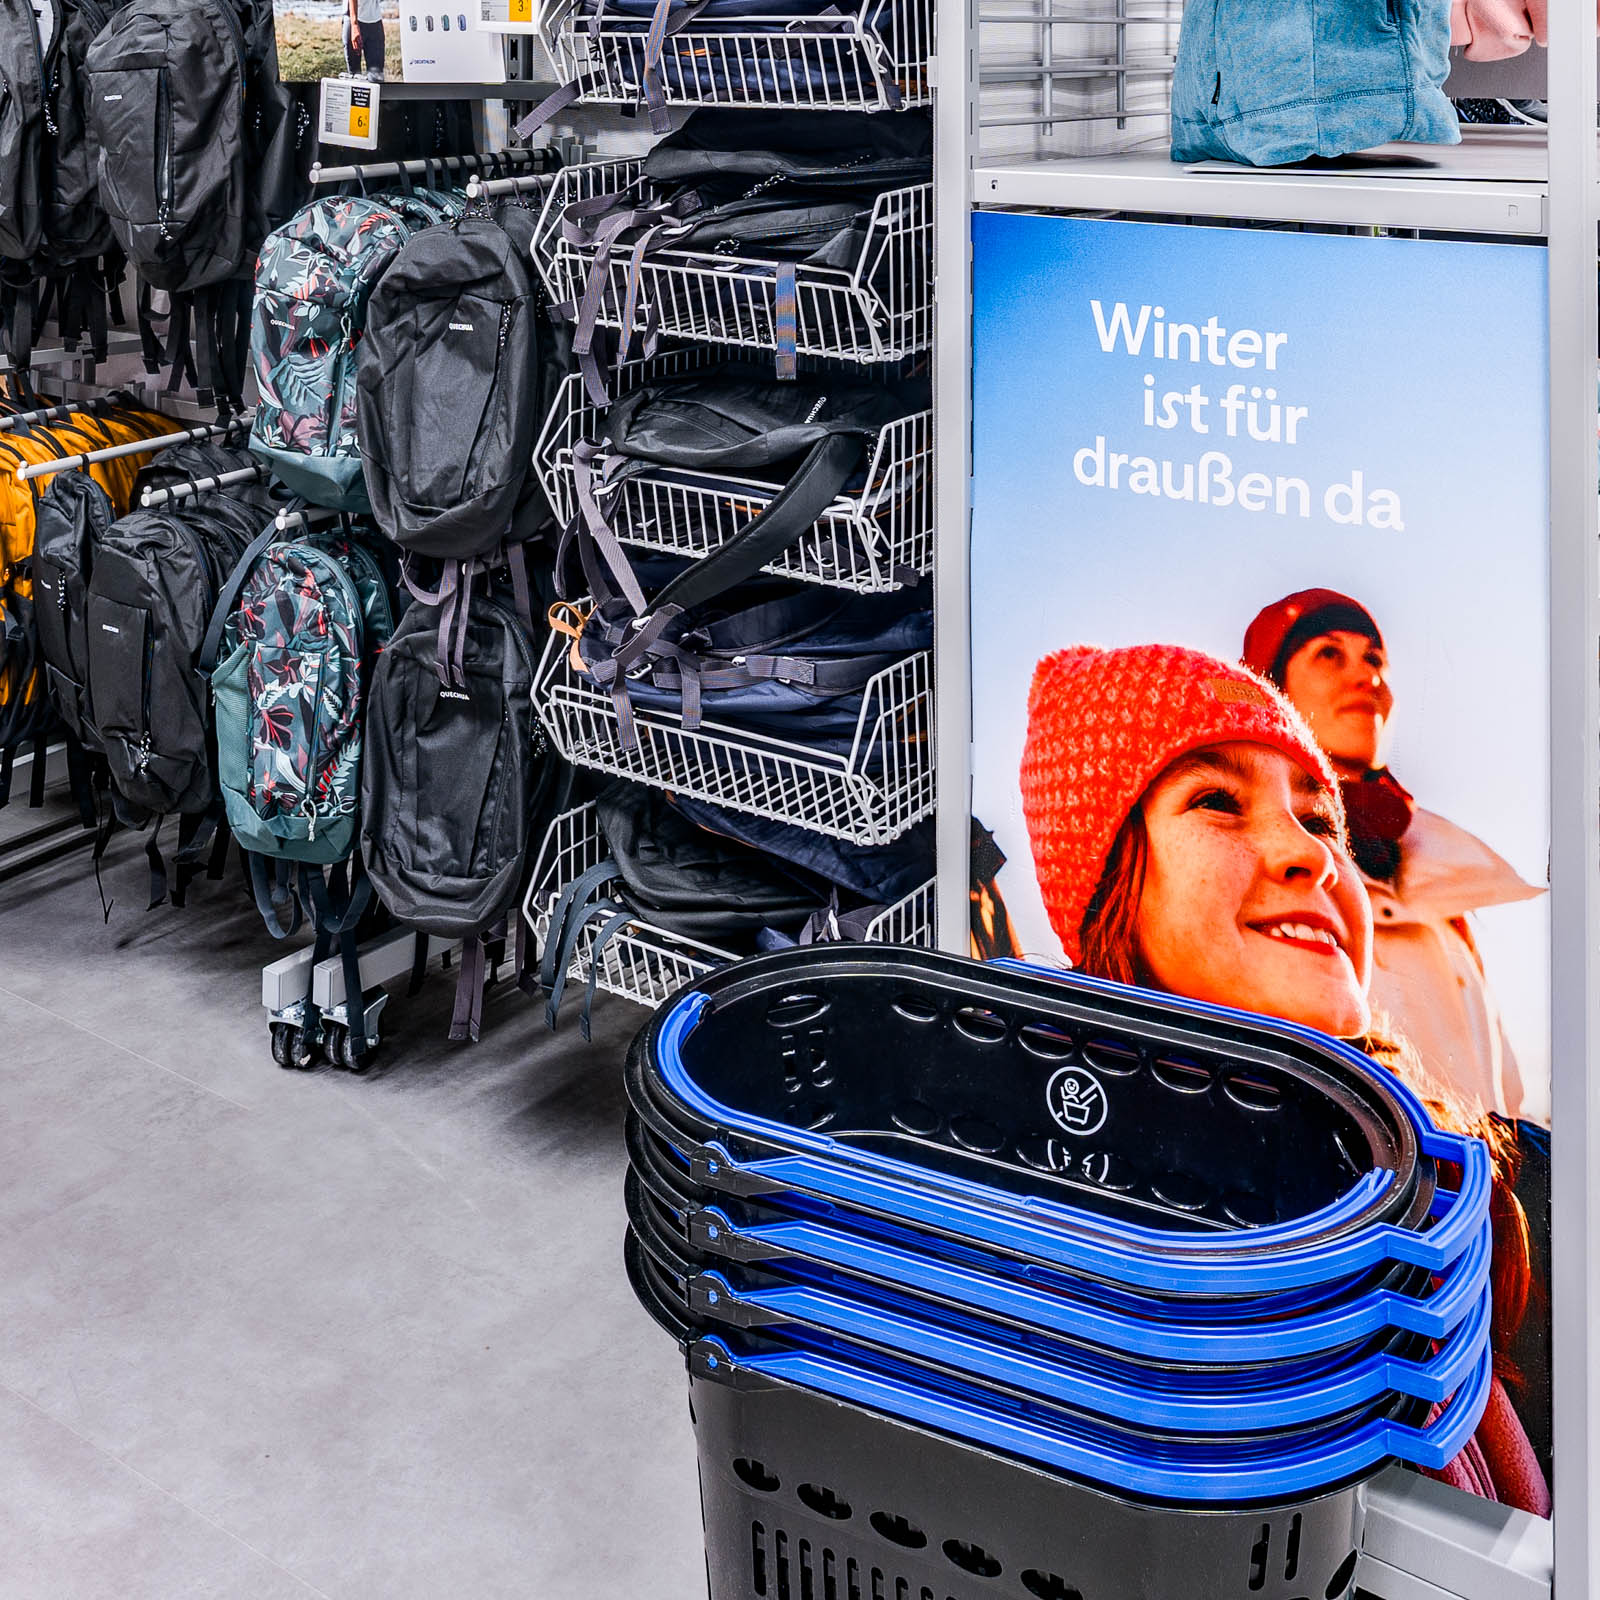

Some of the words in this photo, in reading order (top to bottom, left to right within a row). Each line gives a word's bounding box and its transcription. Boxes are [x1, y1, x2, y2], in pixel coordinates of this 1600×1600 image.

[518, 0, 524, 12] 3
[1090, 300, 1288, 370] Winter
[1143, 374, 1209, 434] ist
[1220, 384, 1308, 444] für
[1073, 435, 1310, 518] draußen
[1324, 470, 1405, 531] da
